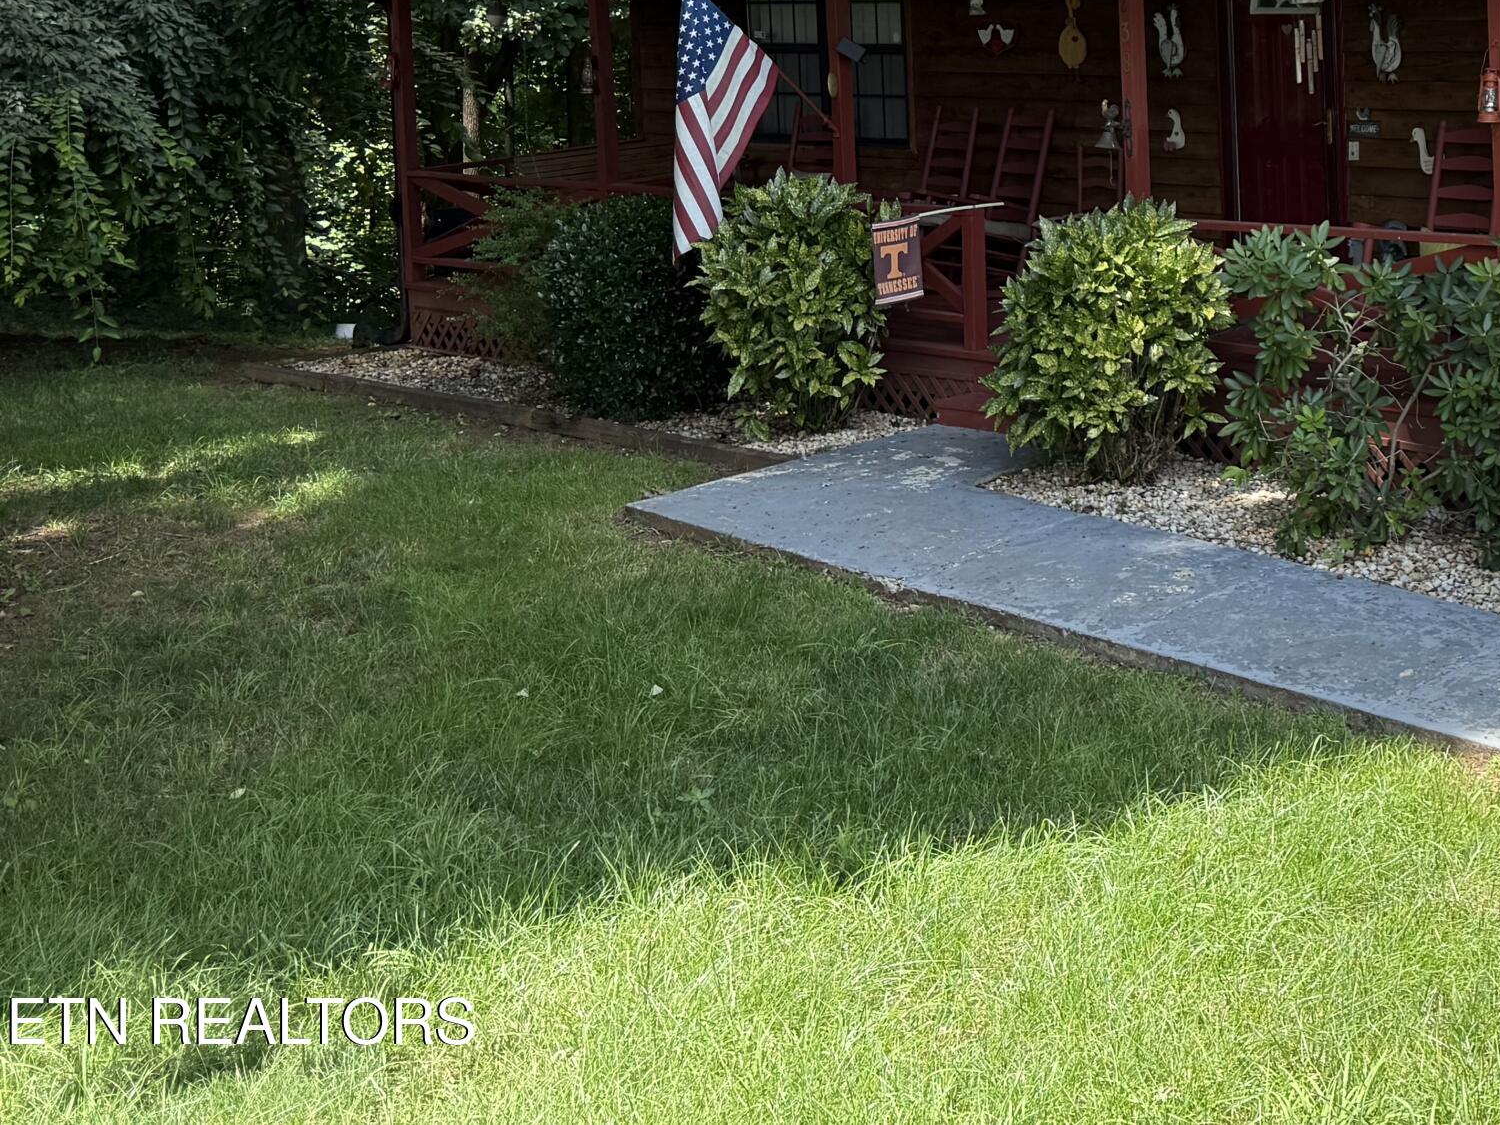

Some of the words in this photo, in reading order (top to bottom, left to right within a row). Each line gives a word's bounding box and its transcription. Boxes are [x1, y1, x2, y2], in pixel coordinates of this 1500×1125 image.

[873, 226, 908, 244] UNIVERSITY
[909, 223, 918, 237] OF
[880, 242, 909, 279] T
[877, 275, 918, 295] TENNESSEE
